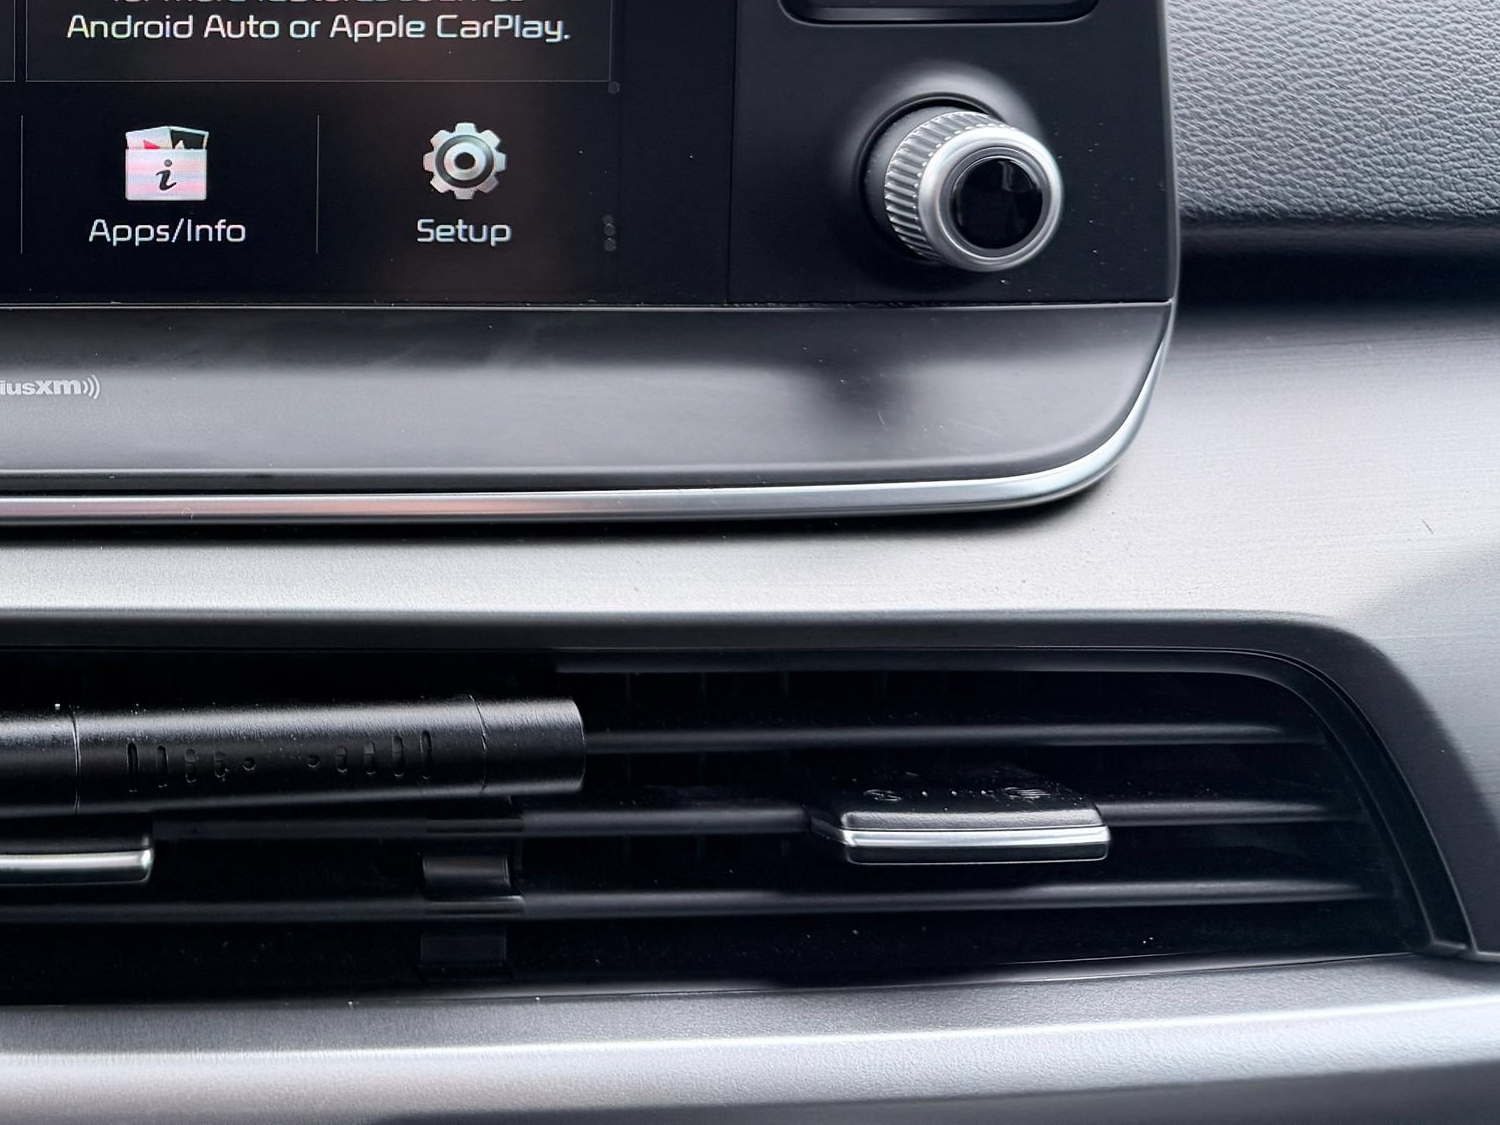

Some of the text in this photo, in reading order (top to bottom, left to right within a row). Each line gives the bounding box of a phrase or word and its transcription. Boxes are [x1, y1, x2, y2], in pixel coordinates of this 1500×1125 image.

[67, 14, 570, 43] Android Auto or Apple CarPlay.
[88, 217, 246, 247] Apps/Info
[416, 218, 512, 247] Setup
